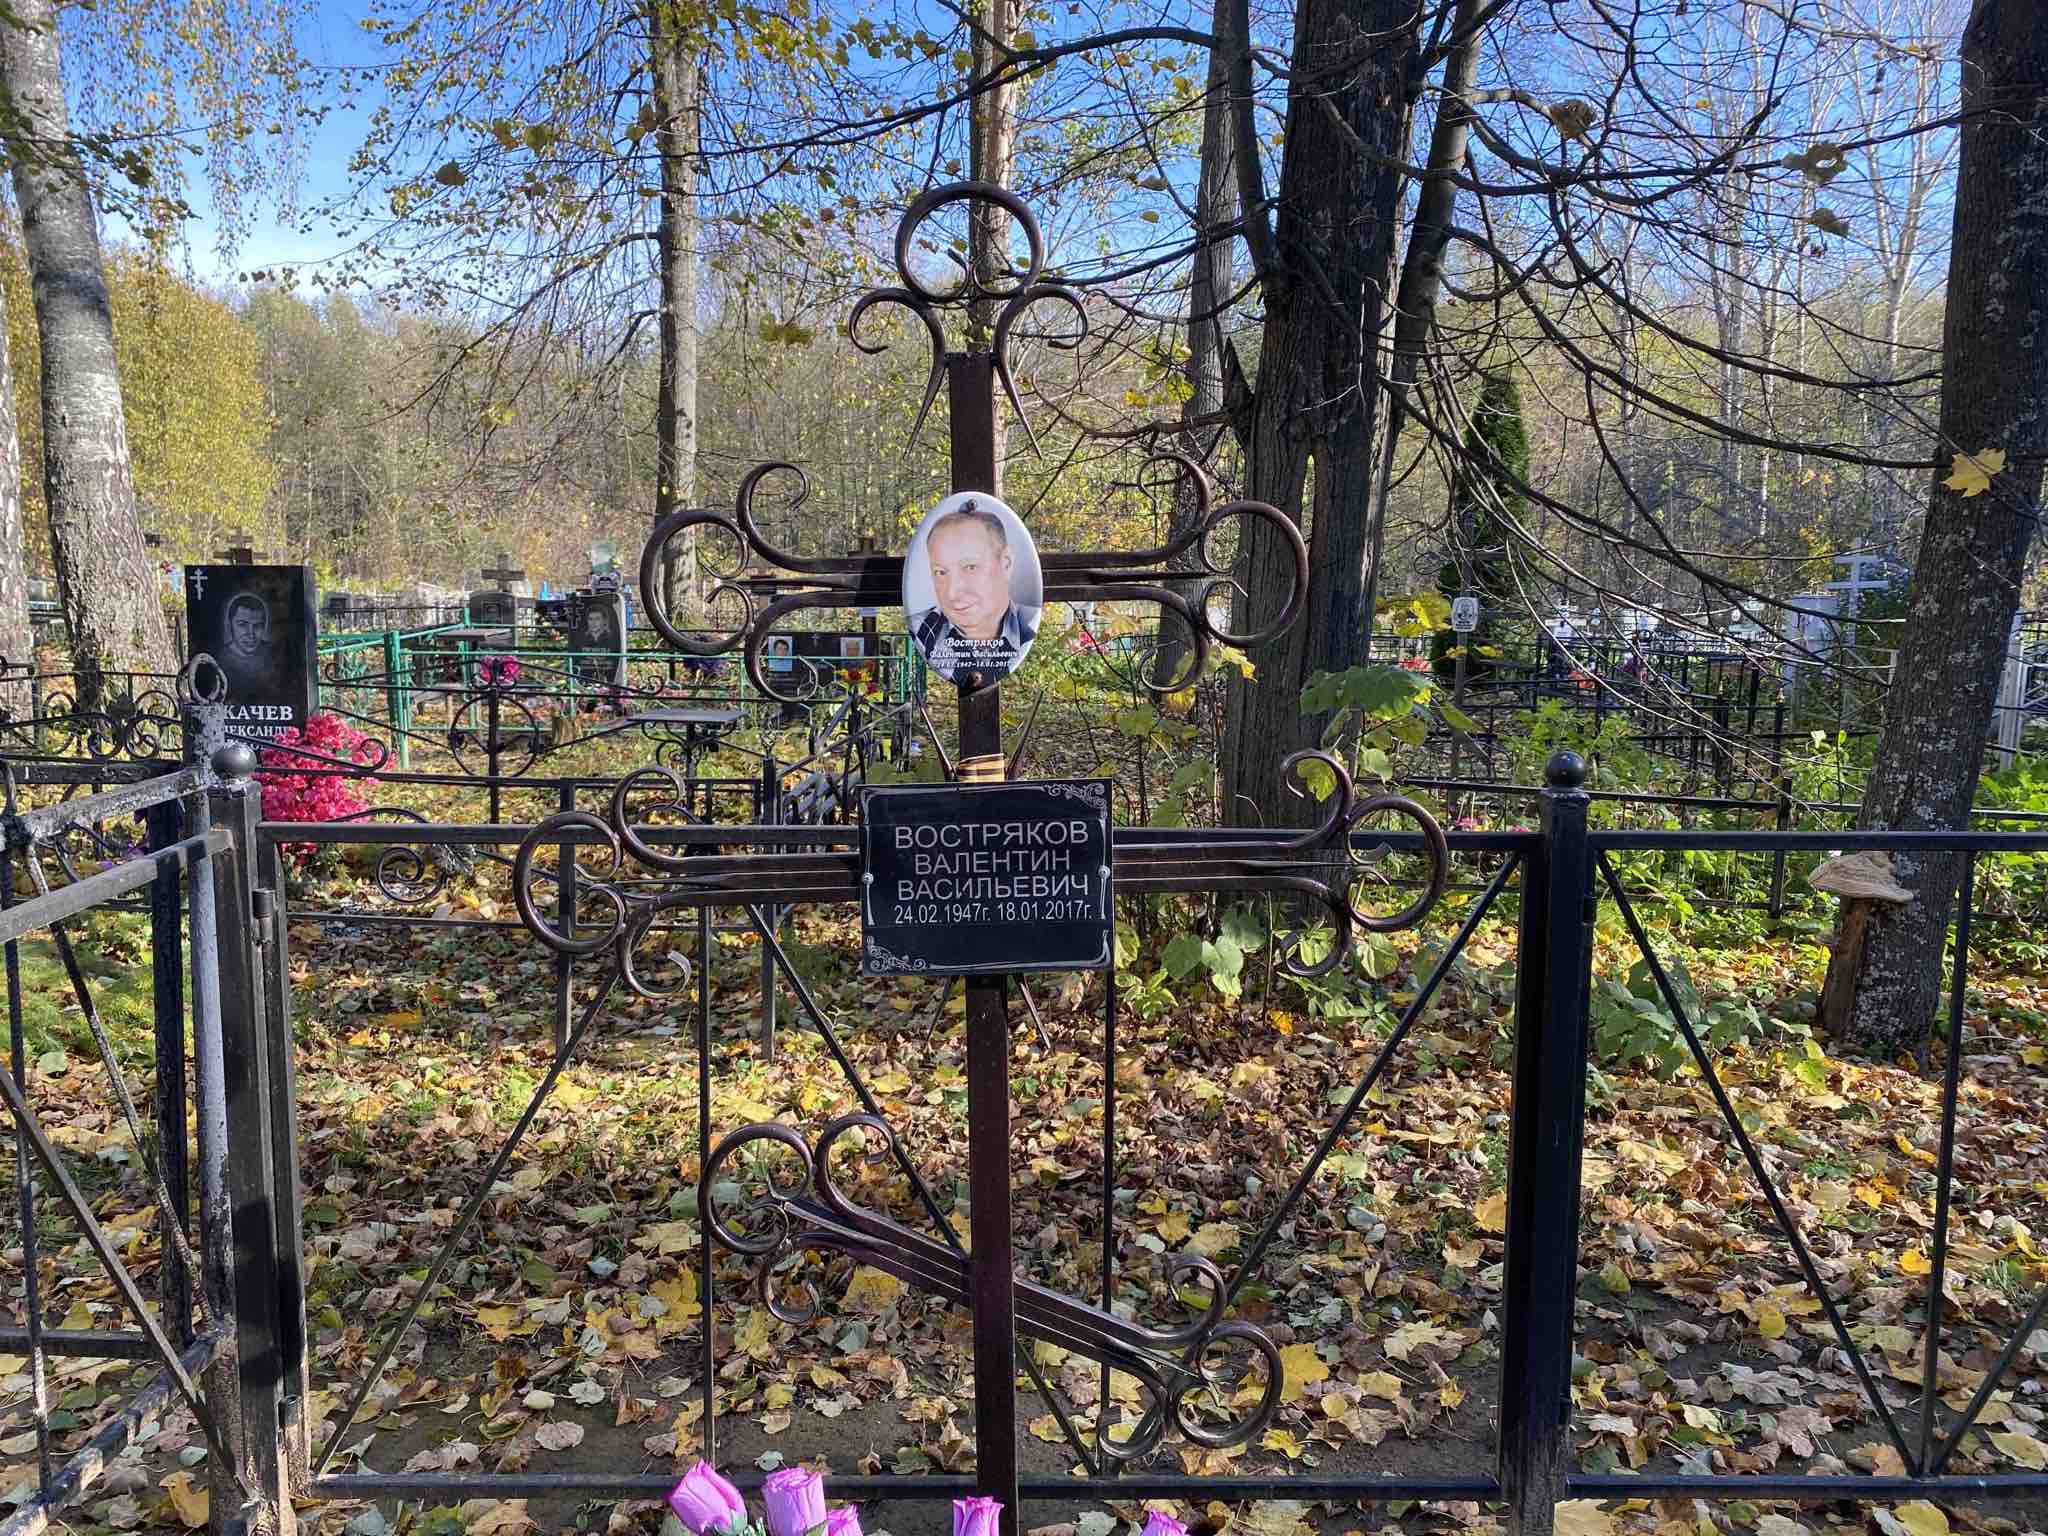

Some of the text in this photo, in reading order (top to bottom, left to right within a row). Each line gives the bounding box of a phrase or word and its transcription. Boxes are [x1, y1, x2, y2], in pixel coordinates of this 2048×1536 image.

[223, 705, 294, 721] КАЧЕВ
[895, 820, 1089, 849] ВОСТРЯКОВ
[915, 849, 1071, 875] ВАЛЕНТИН
[898, 874, 1089, 901] ВАСИЛЬЕВИЧ
[894, 899, 1093, 925] 24.02.1947г. 18.01.2017г.
